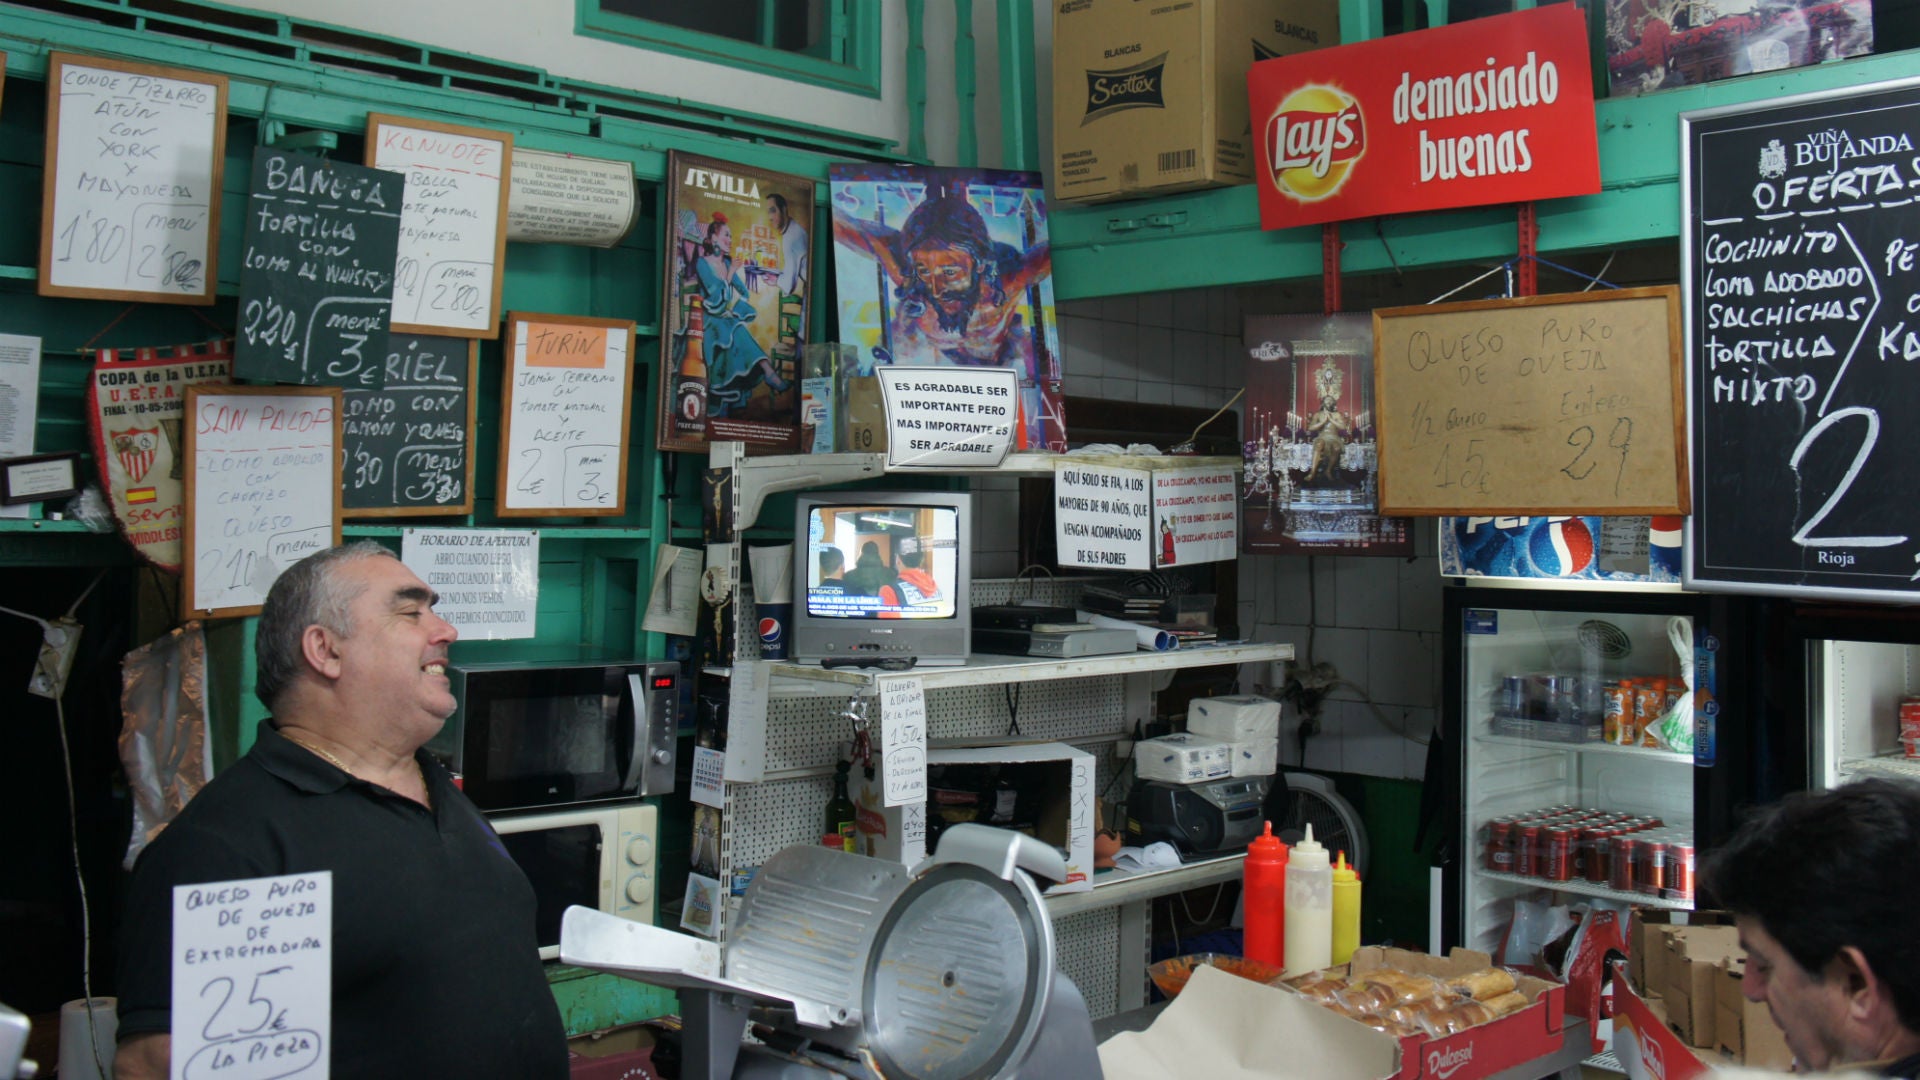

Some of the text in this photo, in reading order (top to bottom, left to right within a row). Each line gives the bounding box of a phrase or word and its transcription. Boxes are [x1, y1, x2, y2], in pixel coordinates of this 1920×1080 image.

[1274, 19, 1319, 45] BLANCAS
[1104, 43, 1141, 59] BLANCAS
[64, 71, 117, 90] CONDE
[1091, 74, 1157, 104] Scottex
[1393, 51, 1559, 124] demasiado
[95, 101, 161, 118] ATÚN
[1275, 109, 1357, 178] Lay's
[1808, 129, 1849, 145] VIÑA
[98, 137, 161, 159] YORK
[1419, 129, 1532, 182] buenas
[1794, 133, 1914, 175] BUJANDA
[124, 163, 137, 175] Y
[78, 172, 192, 199] MAYONESA
[685, 168, 760, 199] SEVILLA
[246, 247, 290, 271] LOMO
[298, 262, 316, 280] AL
[1764, 267, 1864, 293] ADOBADO
[1408, 318, 1613, 372] QUESO PURO
[100, 372, 137, 386] COPA
[144, 371, 160, 383] de
[166, 369, 179, 382] la
[1458, 350, 1608, 386] DE OVEJA
[894, 382, 1008, 397] ES AGRADABLE SER
[104, 405, 126, 416] FINAL
[412, 395, 459, 411] CON
[901, 401, 1006, 416] IMPORTANTE PERO
[199, 403, 249, 434] SAN
[897, 418, 1008, 436] MAS IMPORTANTE ES
[533, 429, 586, 442] ACEITE
[910, 439, 993, 453] SER AGRADABLE
[1560, 416, 1634, 498] 29
[1063, 468, 1144, 491] AQUÍ SOLO SE FIA, A LOS
[1789, 406, 1908, 547] 2
[1059, 496, 1148, 517] MAYORES DE 90 AÑOS, QUE
[420, 535, 531, 546] HORARIO DE APERTURA
[1063, 523, 1142, 541] VENGAN ACOMPAÑADOS
[434, 552, 488, 565] ABRO CUANDO
[1077, 550, 1126, 565] DE SUS PADRES
[1818, 551, 1856, 565] Rioja
[428, 572, 489, 585] CIERRO CUANDO
[448, 592, 460, 604] NO
[462, 592, 477, 604] NOS
[455, 612, 480, 624] HEMOS
[185, 879, 317, 911] QUESO PURO
[218, 909, 243, 927] DE
[247, 926, 270, 941] DE
[185, 937, 321, 964] EXTREMADURA
[211, 1037, 310, 1070] LA PIEZA
[1428, 1041, 1473, 1076] Dulcesol
